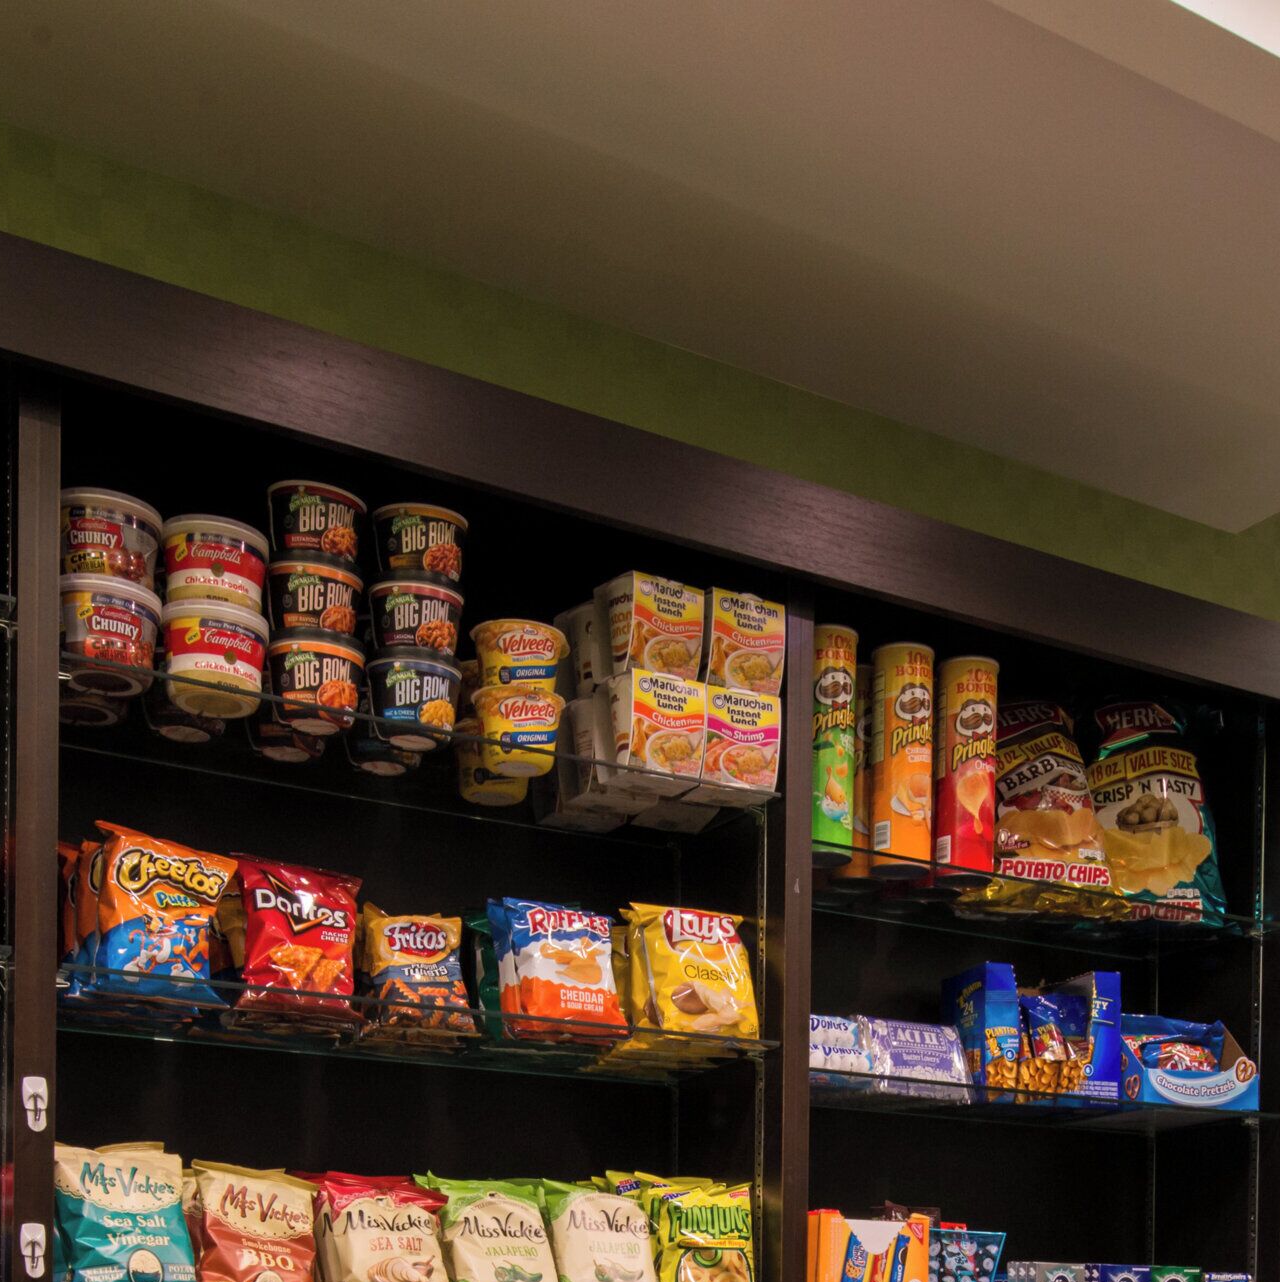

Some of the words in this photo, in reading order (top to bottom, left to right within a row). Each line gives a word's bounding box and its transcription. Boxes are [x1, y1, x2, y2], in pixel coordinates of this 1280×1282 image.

[299, 505, 326, 532] BIG
[70, 530, 118, 549] CHUNKY
[401, 524, 426, 553] BIG
[298, 584, 324, 612] BIG
[394, 602, 419, 630] BIG
[657, 603, 684, 619] Lunch
[733, 609, 768, 626] Instant
[91, 616, 139, 641] CHUNKY
[652, 616, 685, 634] Chicken
[736, 619, 764, 633] Lunch
[501, 632, 555, 657] Velveeta
[731, 630, 767, 648] Chicken
[816, 647, 856, 662] BONUS
[294, 660, 320, 689] BIG
[516, 666, 547, 678] ORIGINAL
[395, 677, 420, 706] BIG
[653, 689, 688, 706] Instant
[502, 698, 557, 722] Velveeta
[656, 698, 685, 713] Lunch
[727, 705, 762, 720] Instant
[651, 710, 687, 728] Chicken
[730, 714, 758, 728] Lunch
[517, 732, 549, 743] ORIGINAL
[732, 729, 765, 743] Shrimp
[1130, 754, 1168, 775] VALUE
[1170, 753, 1195, 773] SIZE
[1094, 785, 1133, 805] CRISP
[119, 848, 227, 900] Cheetos
[1002, 859, 1065, 881] POTATO
[1067, 862, 1110, 886] CHIPS
[154, 890, 200, 909] Puffs
[255, 888, 348, 930] Doritos
[528, 907, 611, 938] RUFFLES
[390, 922, 448, 951] Fritos
[683, 963, 739, 983] Classic
[559, 988, 605, 1005] CHEDDAR
[985, 1026, 1019, 1039] PLANTERS
[1155, 1074, 1199, 1097] Chocolate
[1198, 1081, 1237, 1098] Pretzels
[102, 1214, 133, 1229] Sea
[136, 1214, 168, 1229] Salt
[670, 1203, 752, 1244] FUNYUNS
[106, 1233, 171, 1248] Vinegar
[370, 1236, 394, 1251] SEA
[398, 1236, 424, 1252] SALT
[247, 1249, 296, 1273] BBQ
